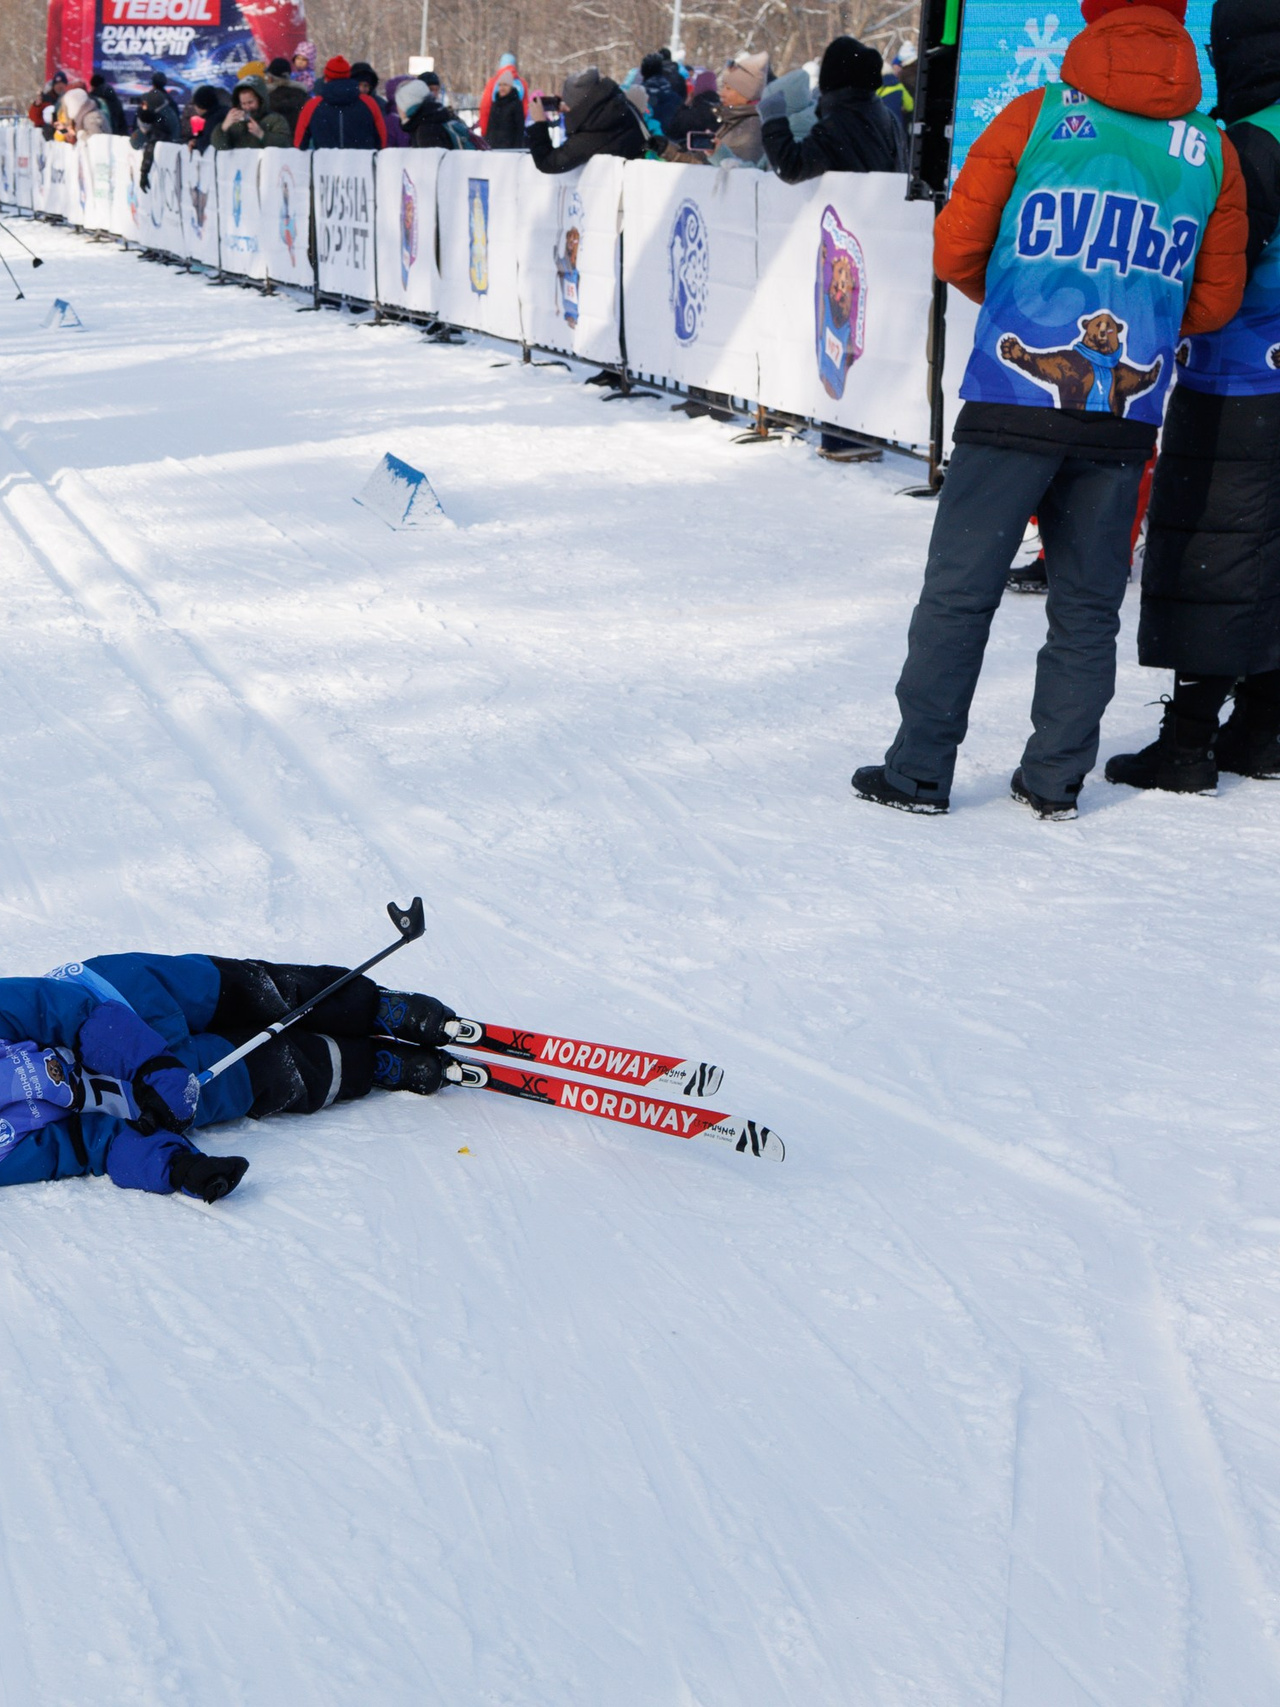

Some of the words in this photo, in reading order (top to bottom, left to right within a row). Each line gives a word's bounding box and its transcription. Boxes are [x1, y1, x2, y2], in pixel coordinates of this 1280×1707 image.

[102, 26, 196, 42] DIAMOND
[111, 0, 212, 21] TEBOIL
[101, 40, 166, 55] CARAT
[1166, 119, 1209, 168] 16
[1018, 190, 1200, 284] СУДЬЯ
[510, 1030, 535, 1051] XC
[540, 1038, 659, 1080] NORDWAY
[520, 1073, 549, 1096] XC
[559, 1084, 698, 1134] NORDWAY
